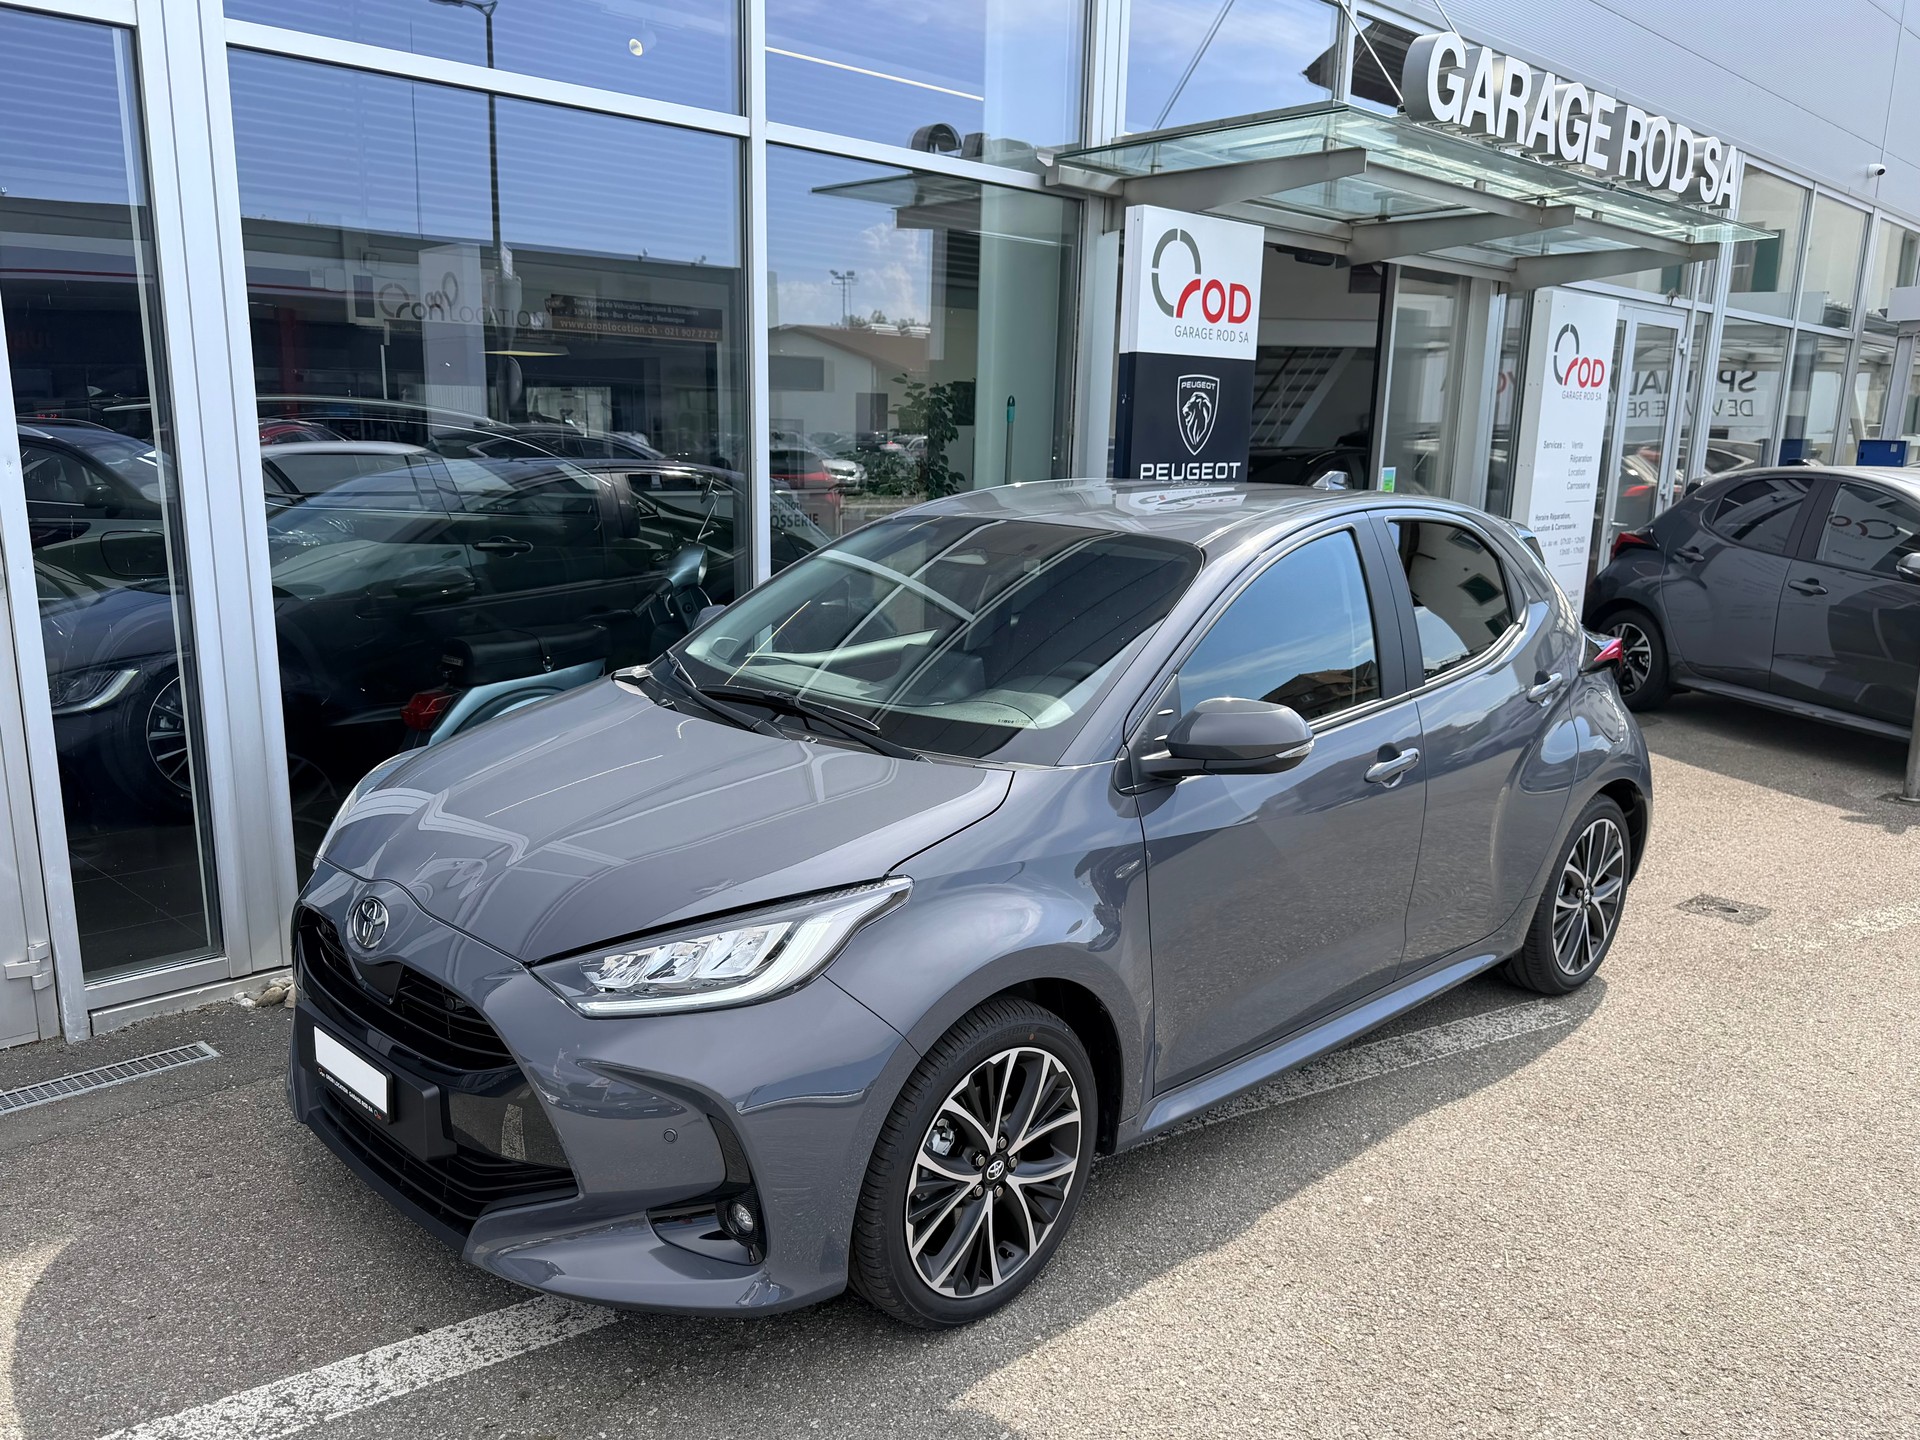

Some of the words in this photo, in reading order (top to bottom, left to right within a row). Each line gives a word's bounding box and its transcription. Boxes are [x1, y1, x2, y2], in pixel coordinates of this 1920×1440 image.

[1427, 32, 1616, 170] GARAGE
[1619, 104, 1694, 193] ROD
[1700, 136, 1737, 209] SA
[450, 305, 545, 328] LOCATION
[1174, 325, 1213, 341] GARAGE
[1216, 327, 1236, 343] ROD
[1238, 330, 1249, 343] SA
[1181, 381, 1216, 390] PEUGEOT
[1562, 391, 1583, 400] GARAGE
[1583, 391, 1594, 401] ROD
[1140, 462, 1241, 480] PEUGEOT
